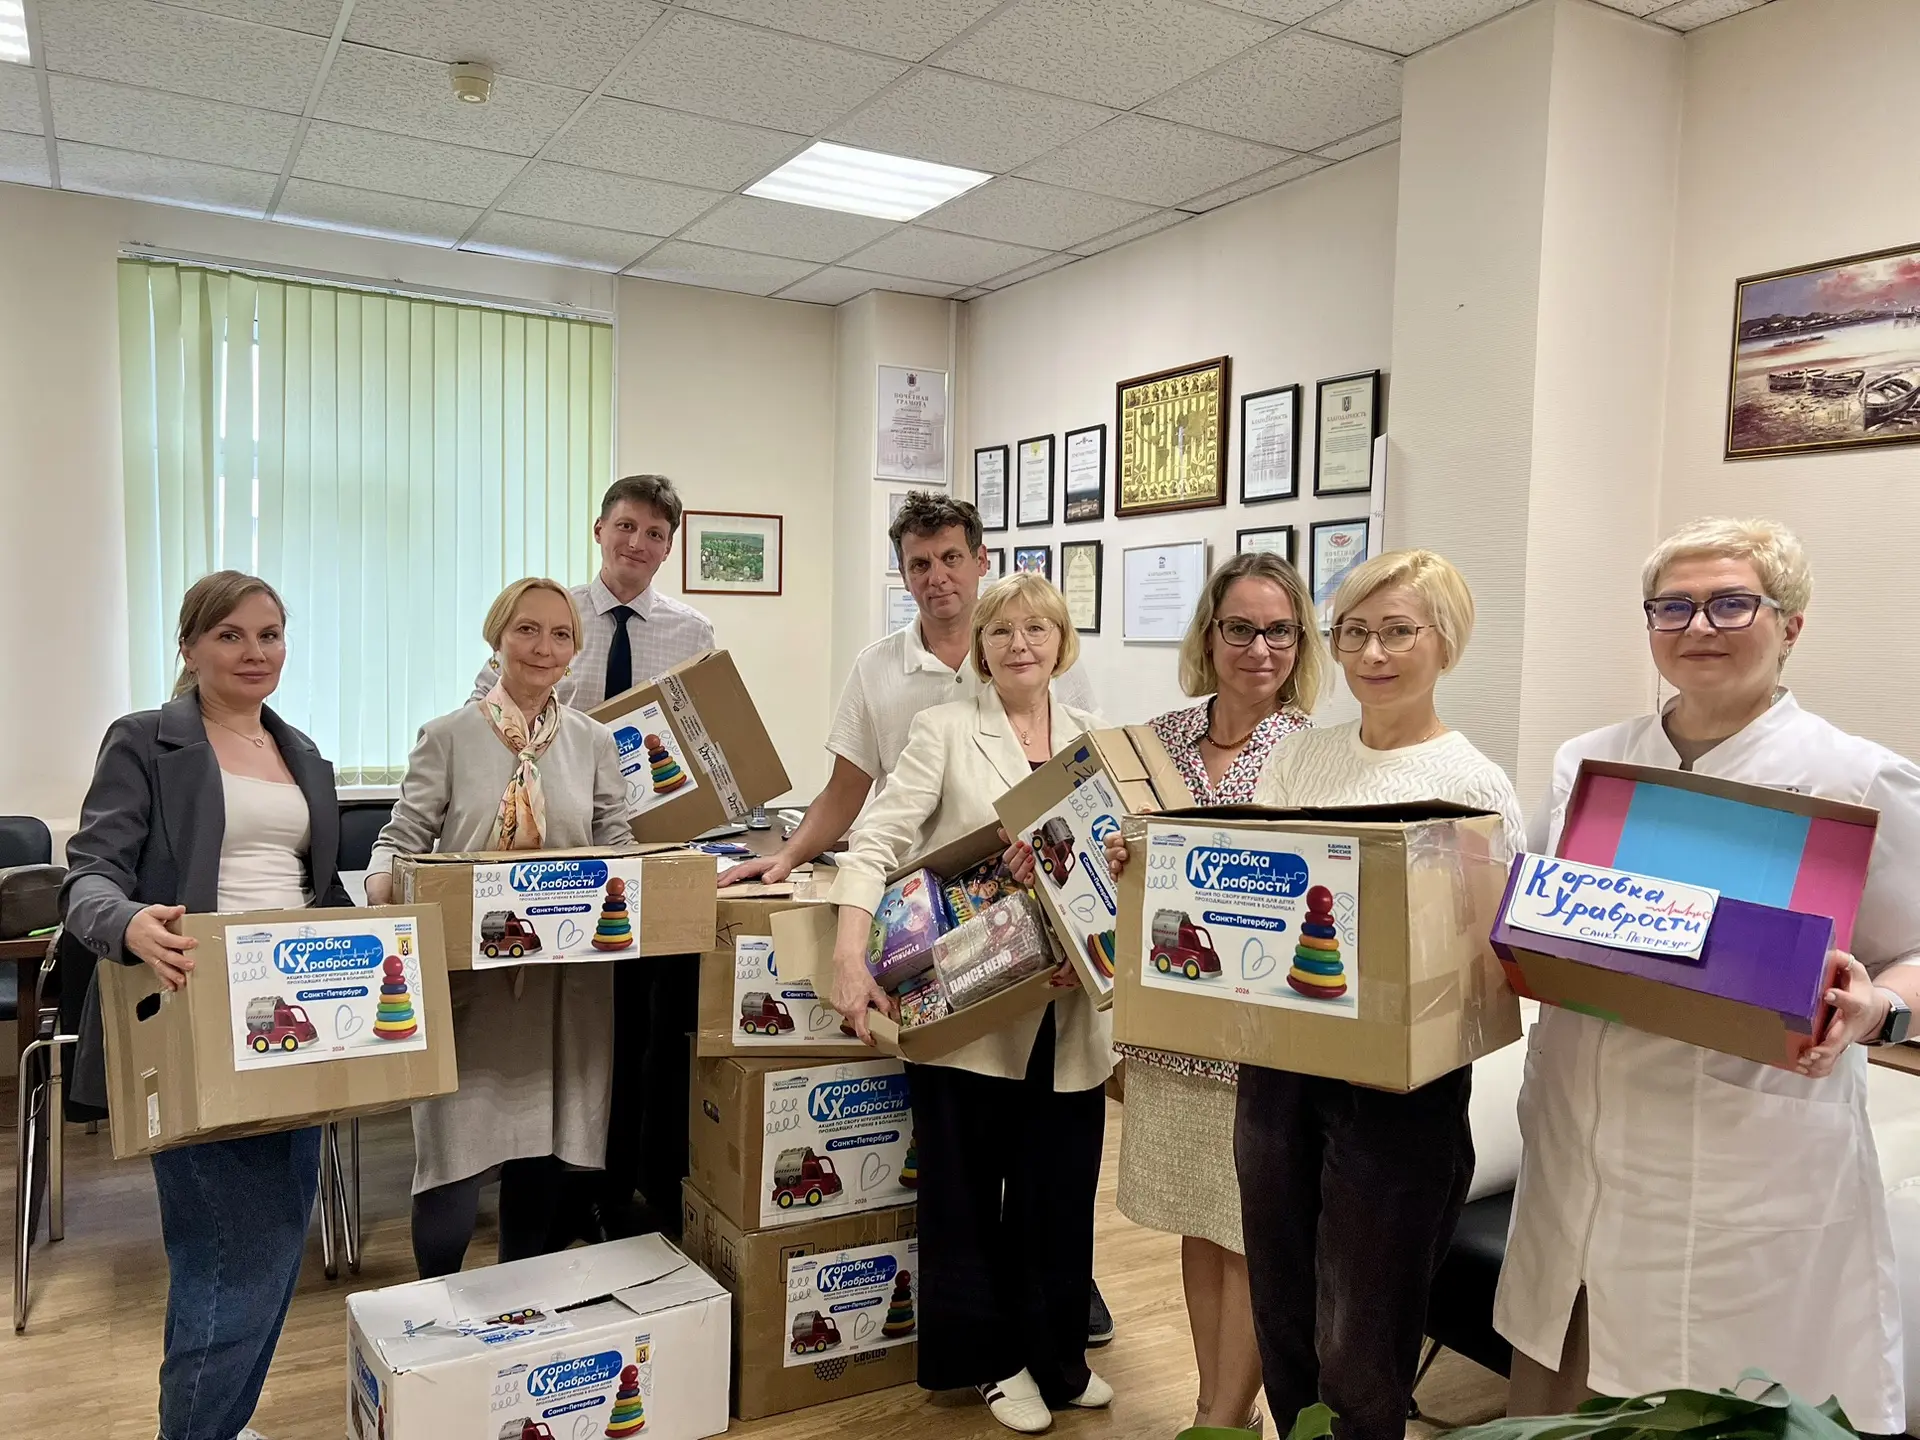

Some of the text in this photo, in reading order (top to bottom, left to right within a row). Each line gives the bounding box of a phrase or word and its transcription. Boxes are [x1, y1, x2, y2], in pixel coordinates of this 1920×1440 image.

[513, 861, 579, 887] Коробка
[1189, 850, 1270, 881] Коробка
[526, 874, 594, 891] Храбрости
[1204, 865, 1290, 893] Храбрости
[1525, 859, 1664, 905] Коробка
[531, 905, 586, 914] Санкт-Петербург
[1209, 912, 1279, 929] Санкт-Петербург
[278, 938, 352, 969] Коробка
[294, 954, 369, 973] Храбрости
[303, 988, 362, 999] Санкт-Петербург
[1235, 986, 1250, 995] 2026
[812, 1079, 887, 1116] Коробка
[827, 1098, 904, 1120] Храбрости
[832, 1134, 894, 1148] Санкт-Петербург
[819, 1260, 874, 1290] Коробка
[829, 1274, 886, 1292] Храбрости
[834, 1299, 878, 1311] Санкт-Петербург
[530, 1358, 595, 1393] Коробка
[544, 1371, 609, 1394] Храбрости
[547, 1399, 600, 1415] Санкт-Петербург
